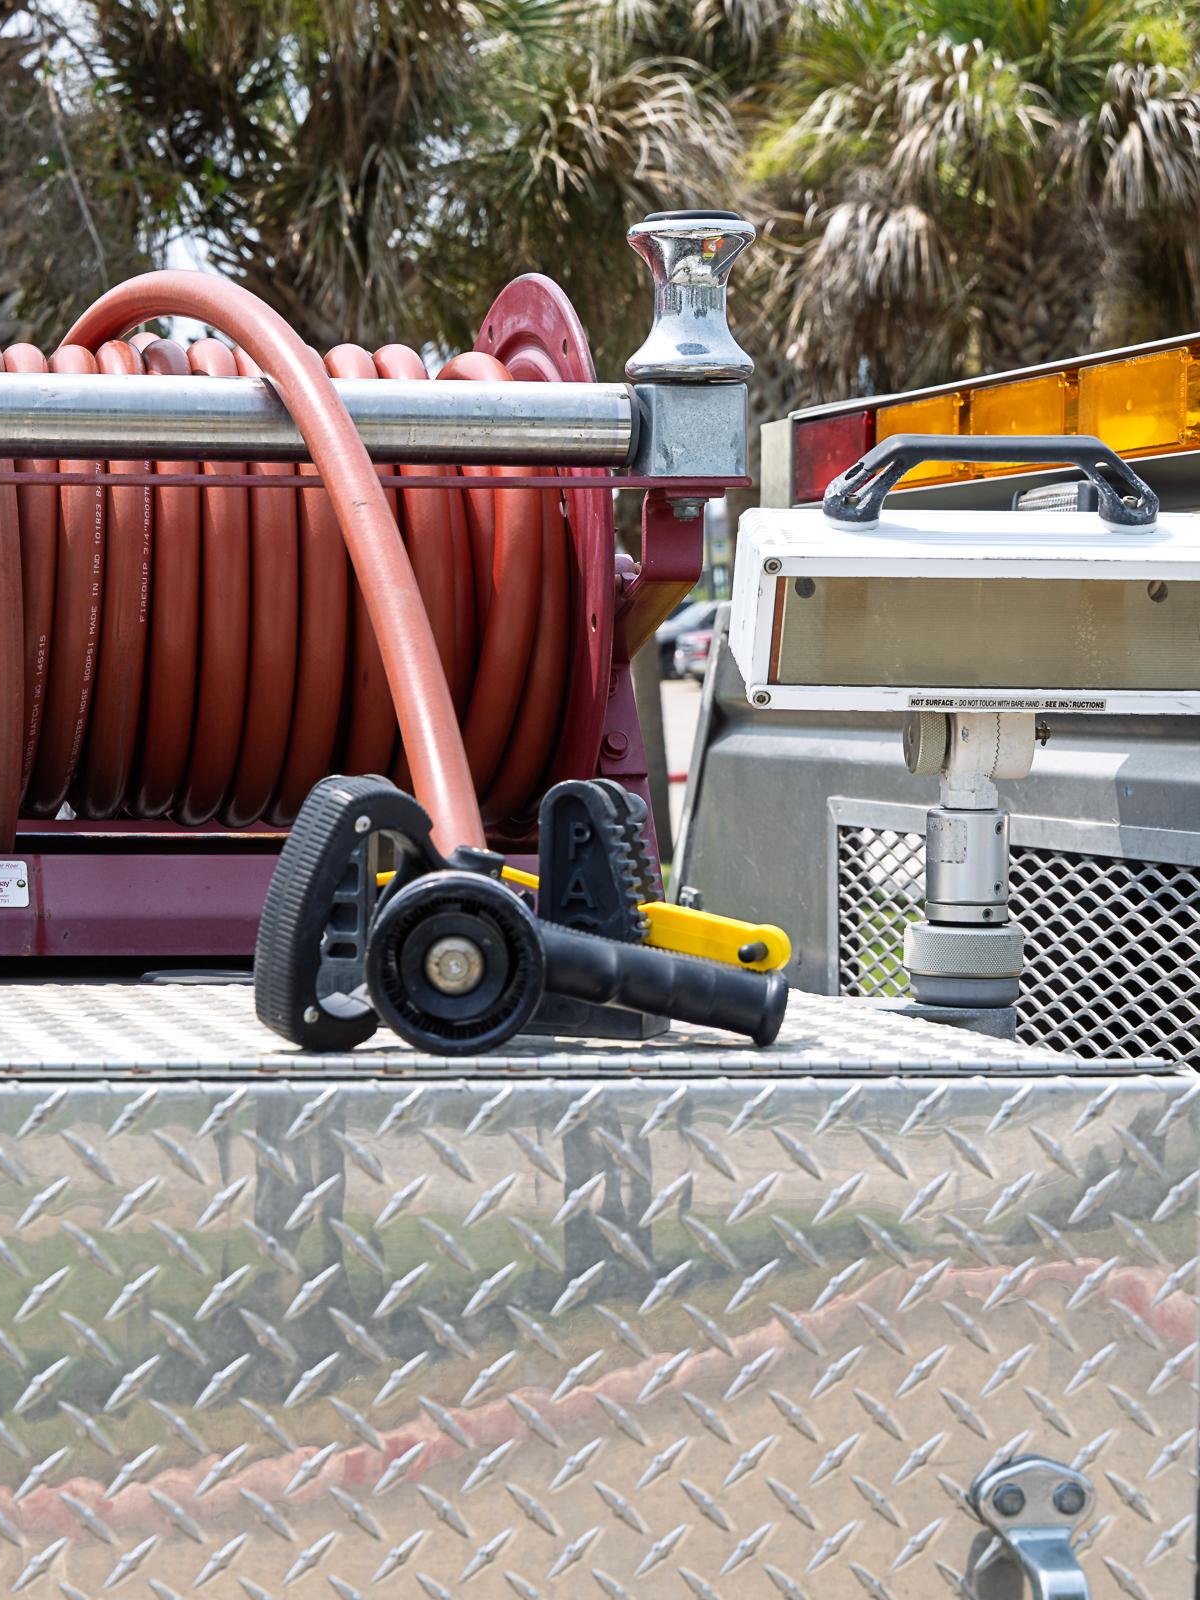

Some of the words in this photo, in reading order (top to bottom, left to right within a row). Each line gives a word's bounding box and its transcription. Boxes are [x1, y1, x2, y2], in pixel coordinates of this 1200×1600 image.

[92, 583, 99, 596] IN
[139, 562, 148, 623] FIREQUIP
[89, 605, 98, 635] MADE
[36, 634, 46, 675] 145215
[34, 680, 42, 698] NO.
[79, 688, 89, 713] HOSE
[968, 699, 979, 707] NOT
[980, 699, 996, 707] TOUCH
[1045, 700, 1057, 708] SEE
[31, 703, 40, 736] BATCH
